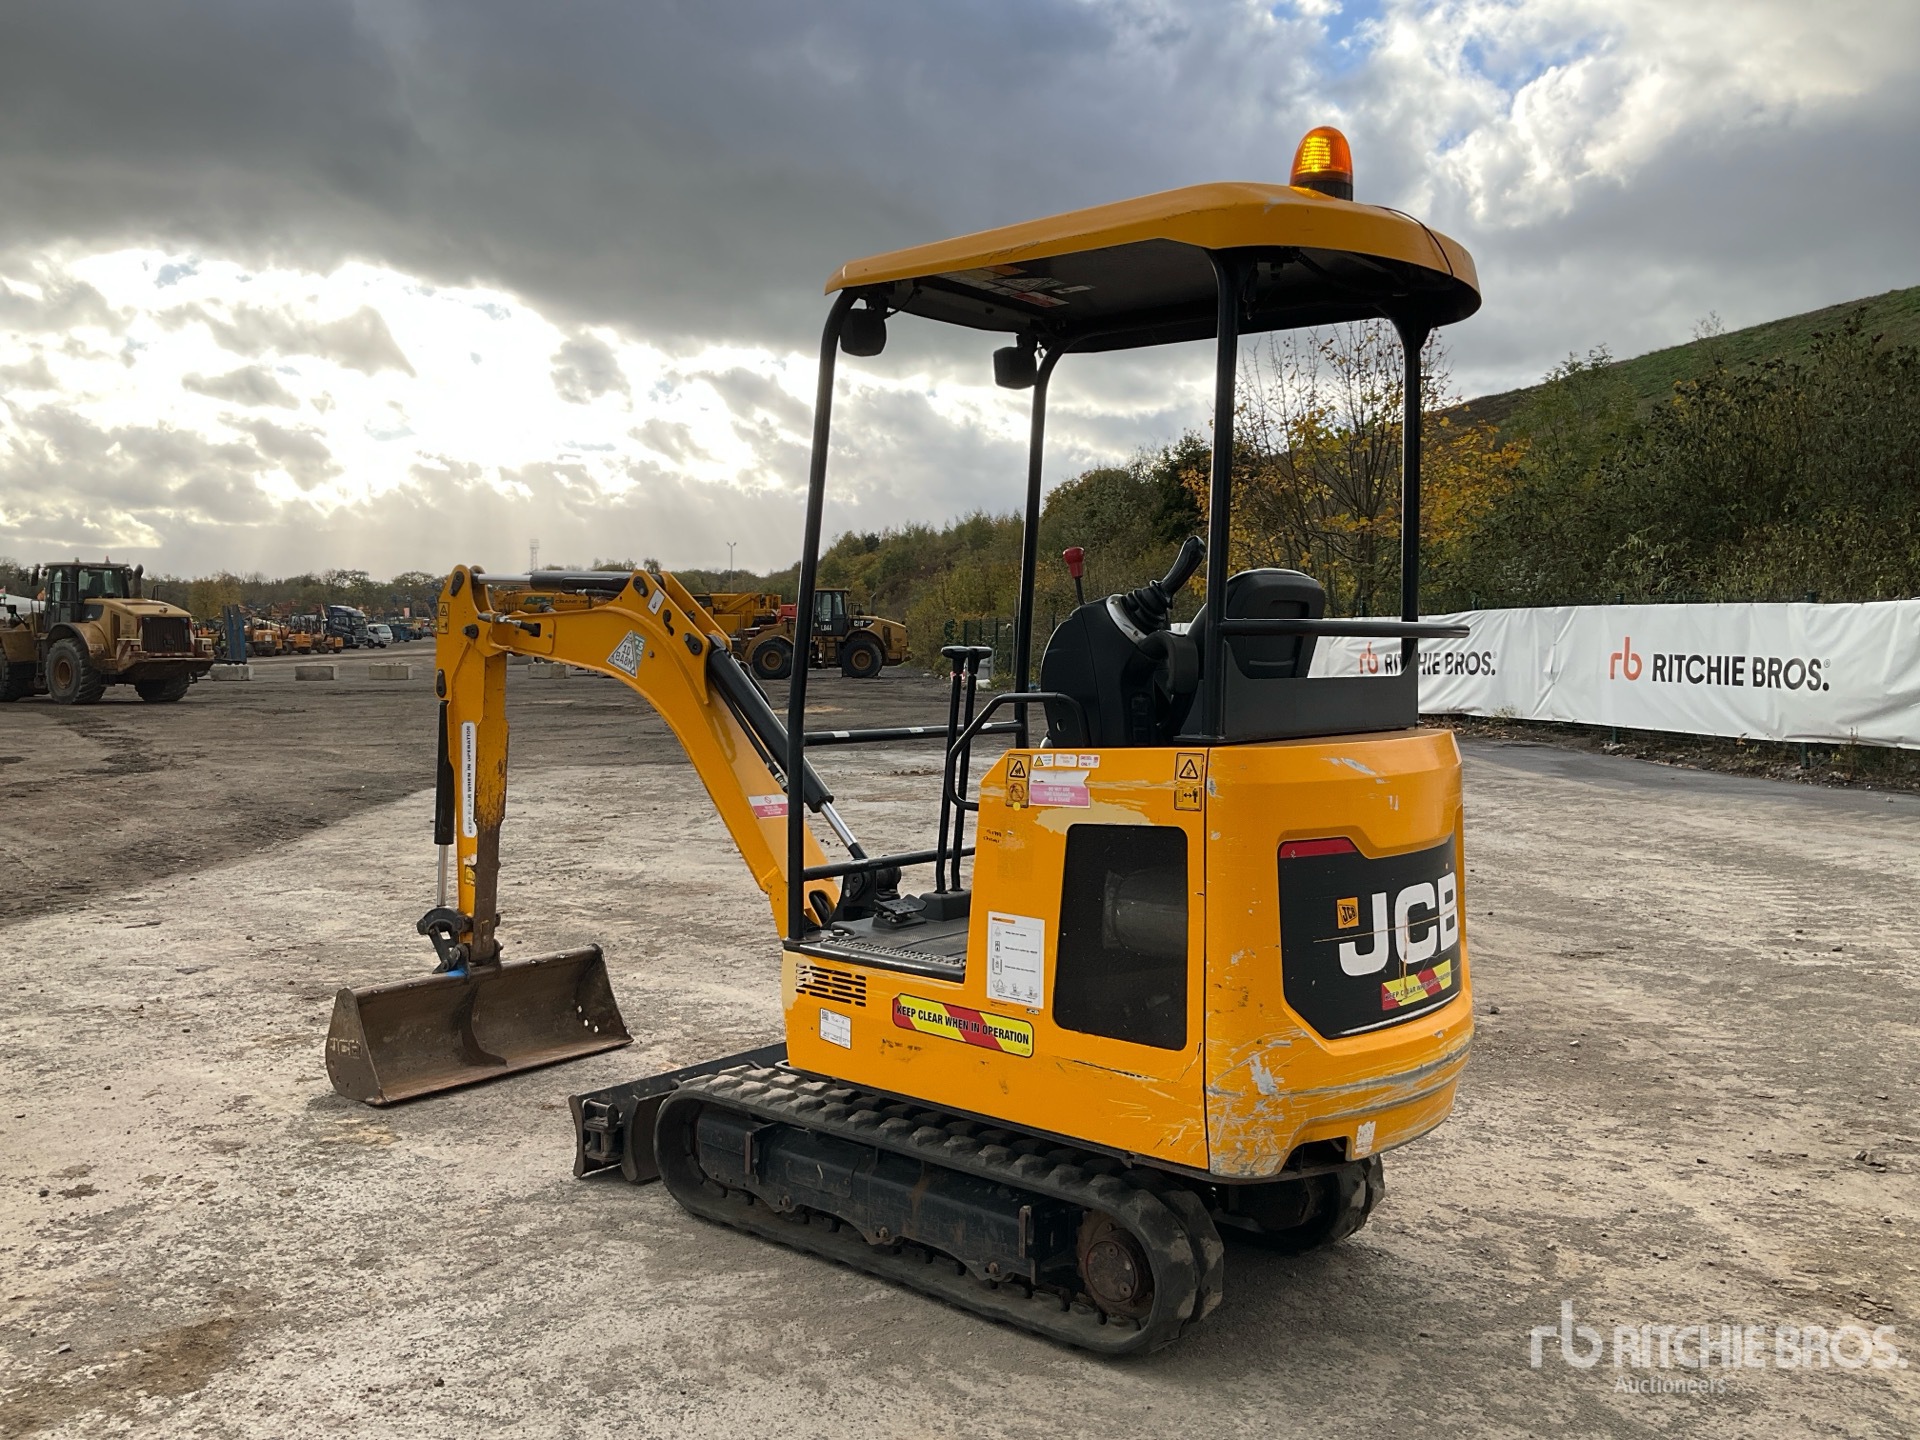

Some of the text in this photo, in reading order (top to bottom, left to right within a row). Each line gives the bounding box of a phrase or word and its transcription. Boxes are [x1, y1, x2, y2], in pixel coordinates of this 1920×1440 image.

[1384, 653, 1441, 675] RIHIE
[1652, 653, 1746, 687] RITCHIE
[1339, 871, 1459, 977] JCB
[1341, 905, 1357, 922] JCB
[896, 1005, 1029, 1045] KEEP CLEAR WHEN IN OPERATION
